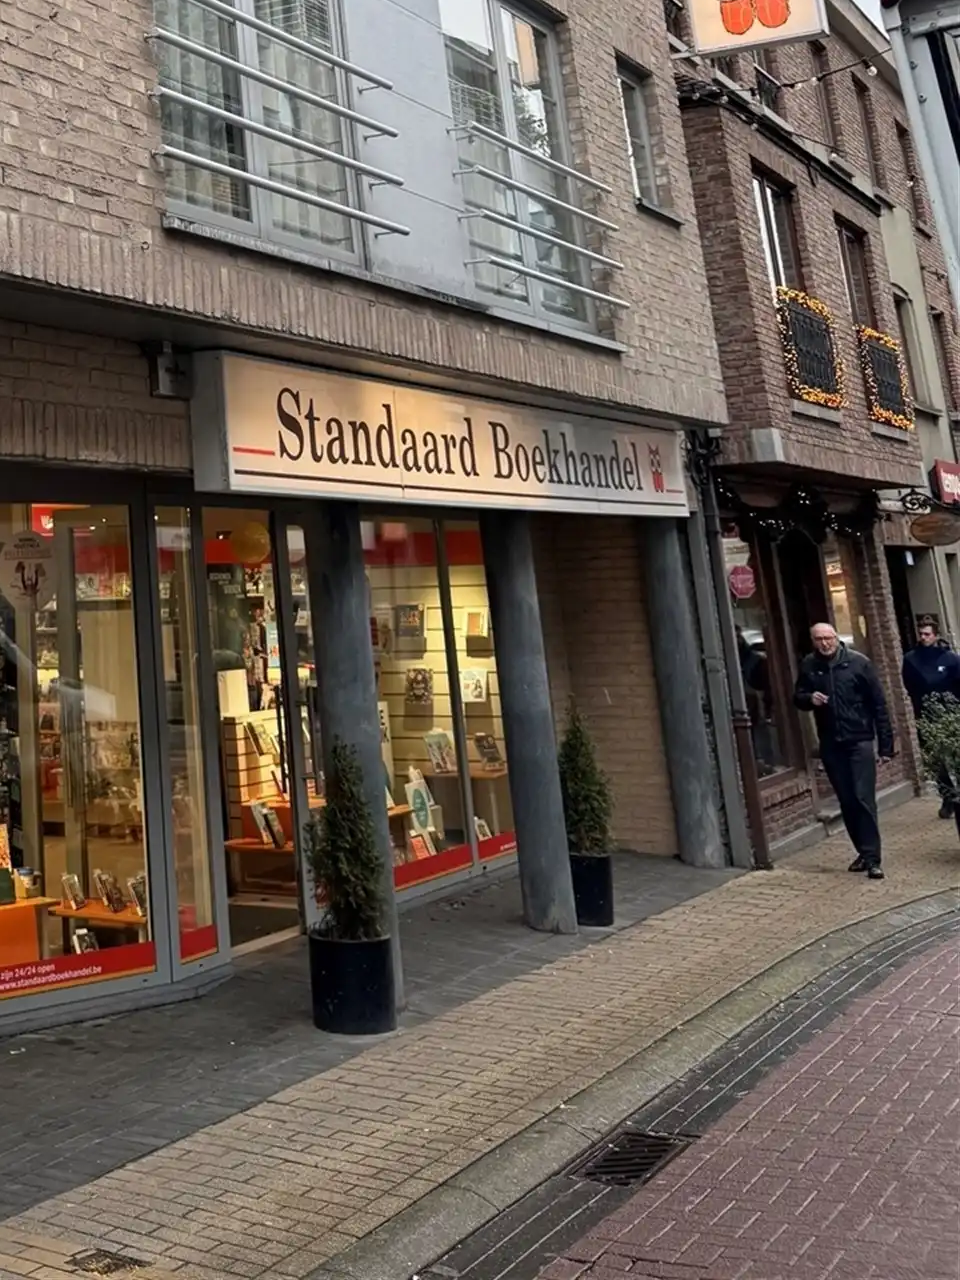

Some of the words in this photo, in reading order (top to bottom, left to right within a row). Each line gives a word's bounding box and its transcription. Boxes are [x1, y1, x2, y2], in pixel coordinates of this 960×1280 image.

[276, 387, 479, 478] Standaard
[488, 421, 645, 492] Boekhandel
[0, 971, 13, 981] zijn
[14, 967, 36, 978] 24/24
[37, 964, 55, 974] open
[0, 965, 102, 990] www.standaardboekhandel.be
